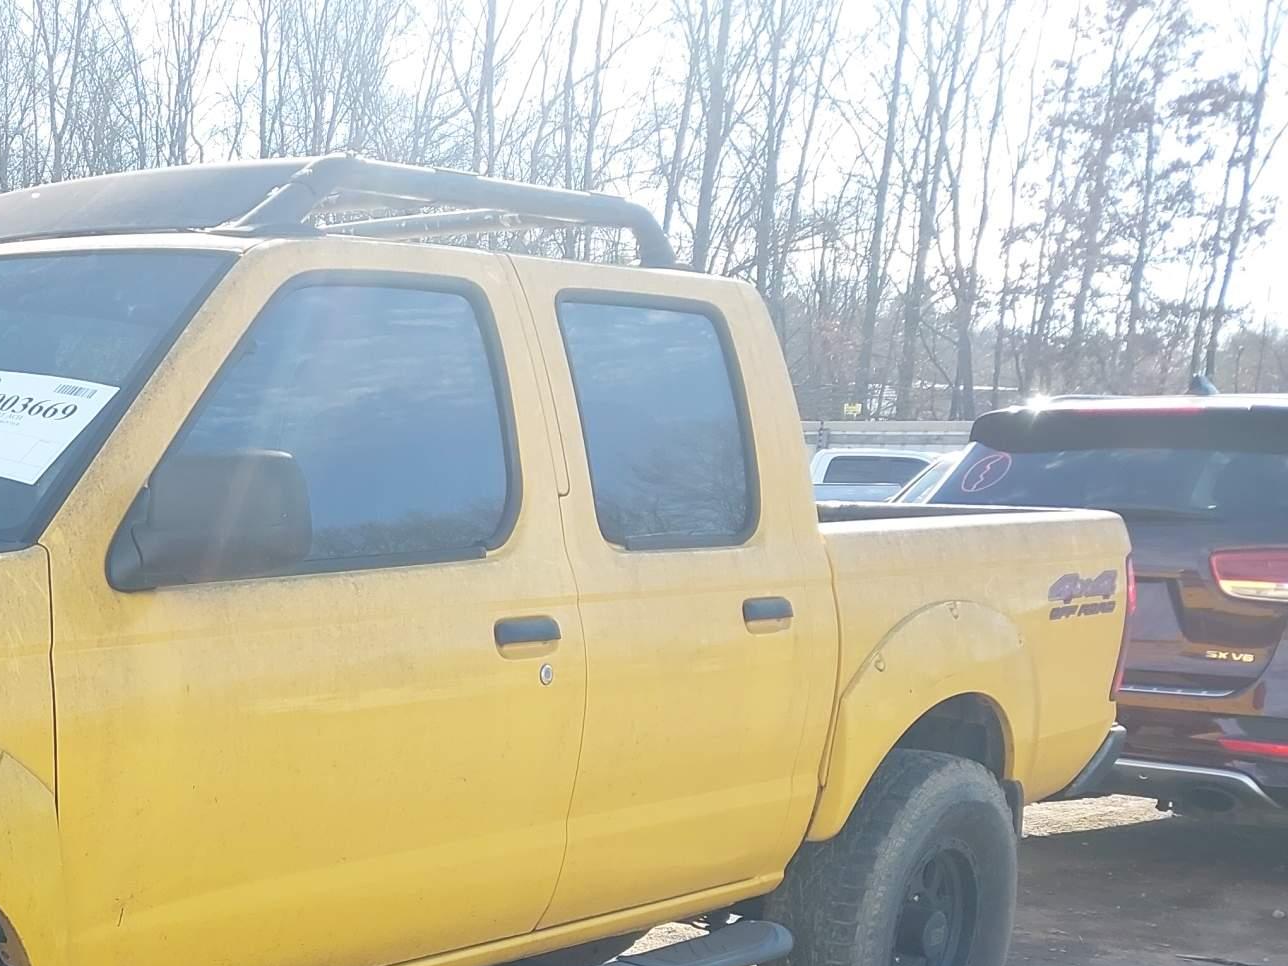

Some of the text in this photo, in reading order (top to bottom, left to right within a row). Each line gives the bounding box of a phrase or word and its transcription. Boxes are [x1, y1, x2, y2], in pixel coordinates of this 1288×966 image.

[1049, 600, 1116, 620] OFF ROAD
[1205, 650, 1230, 659] SX
